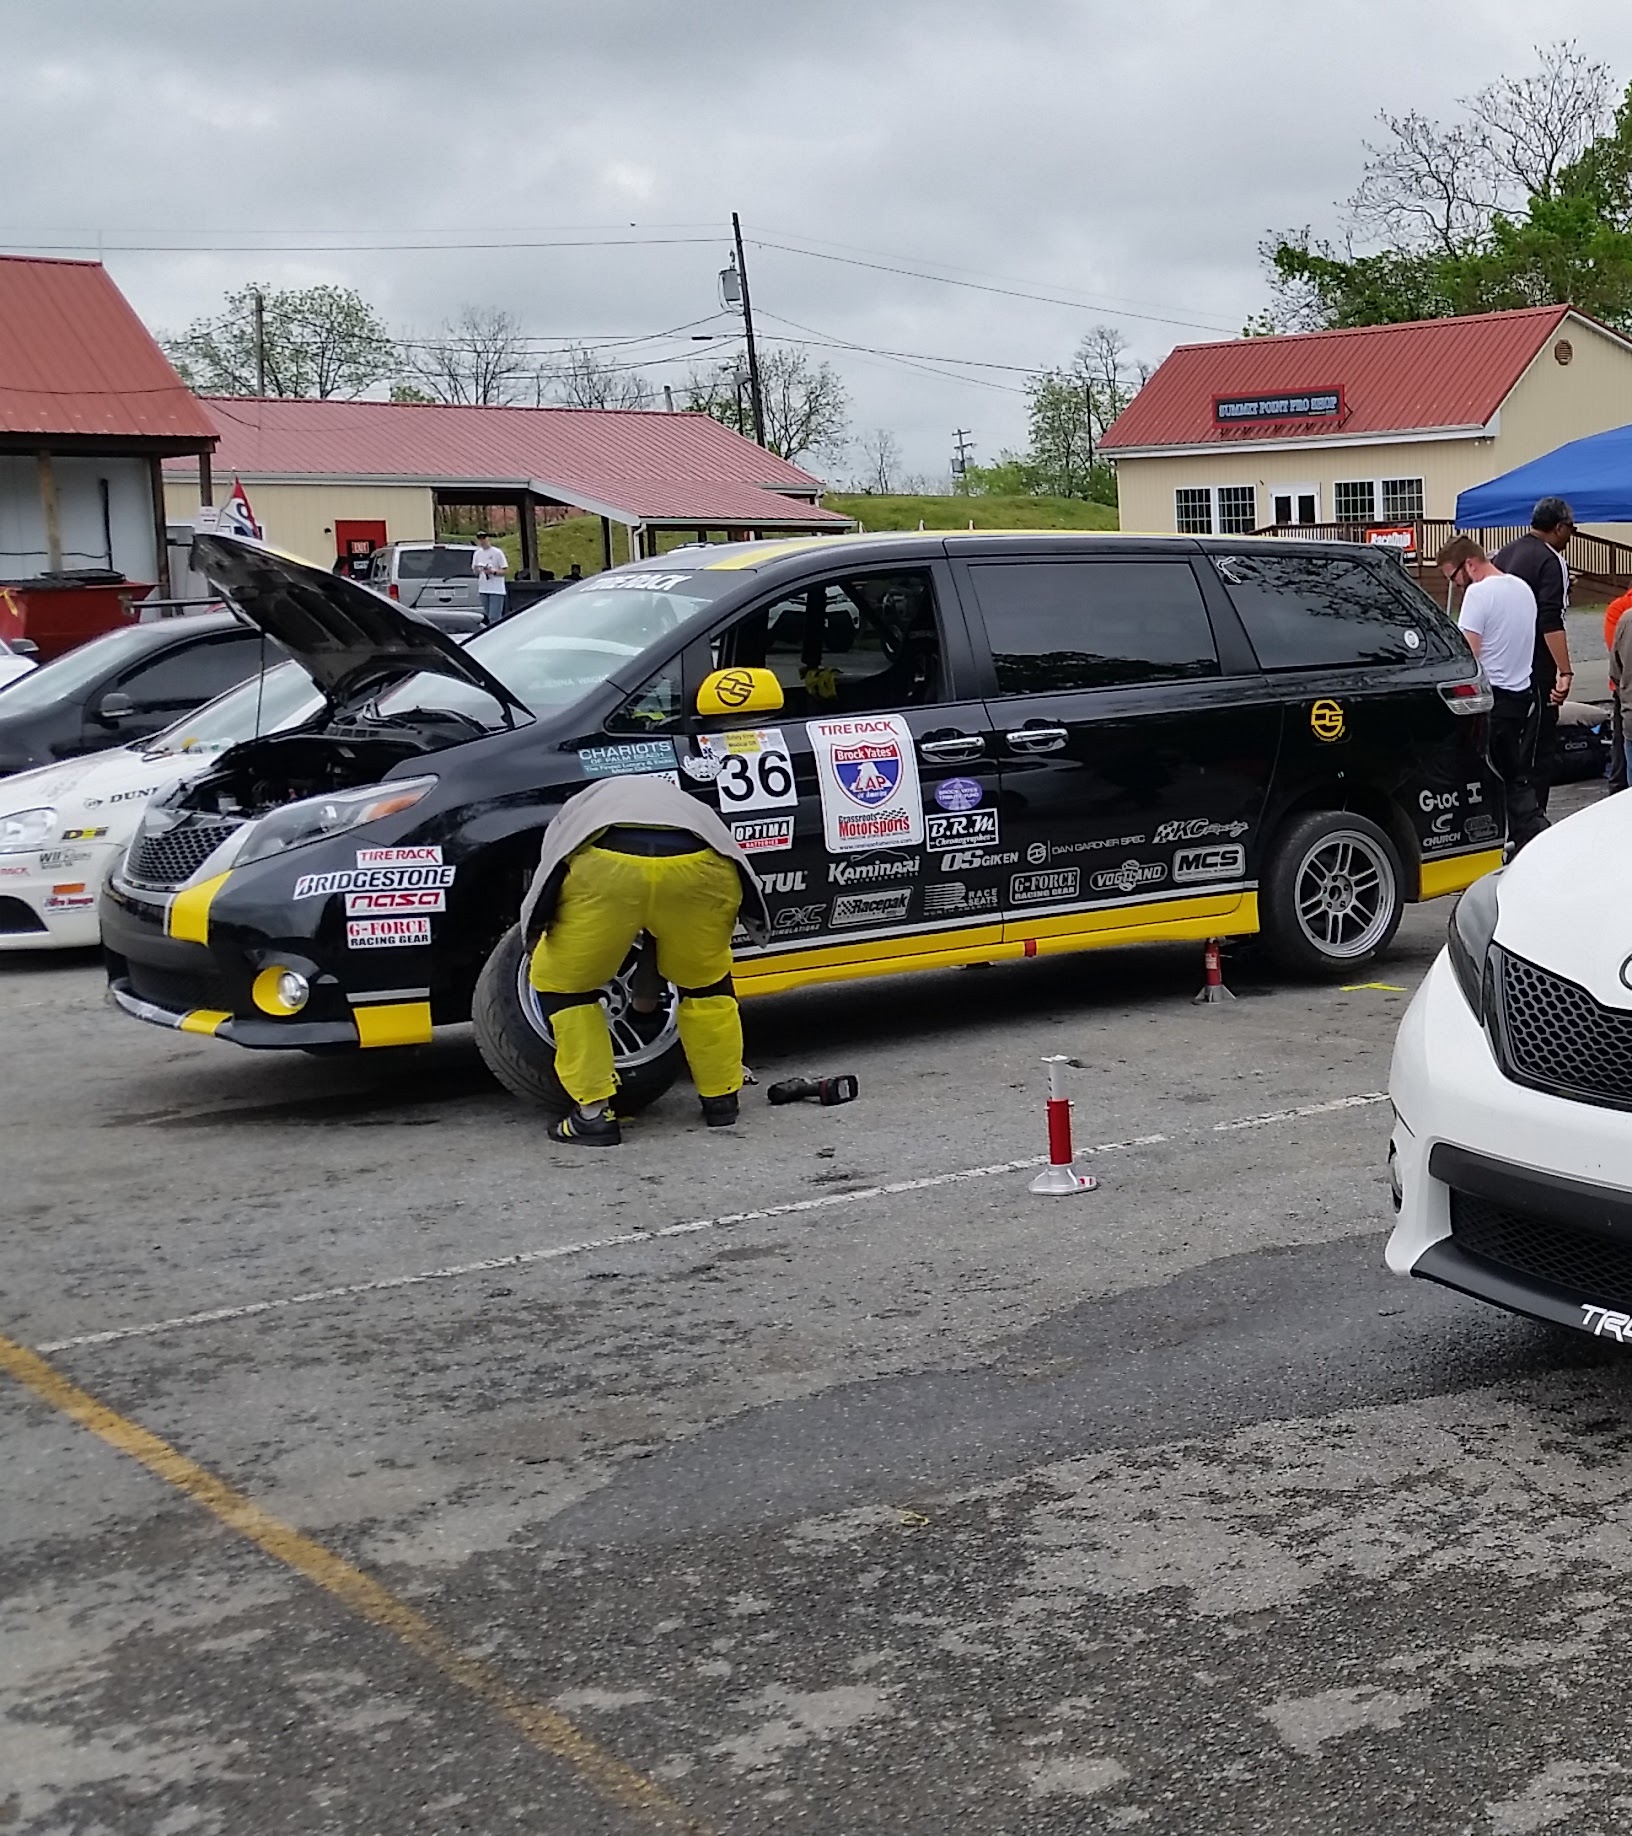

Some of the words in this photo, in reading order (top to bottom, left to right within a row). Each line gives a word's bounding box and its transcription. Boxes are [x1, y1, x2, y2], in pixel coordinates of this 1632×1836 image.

[1219, 403, 1258, 417] SUMMIT
[1259, 400, 1288, 414] POINT
[1290, 398, 1310, 412] PRO
[1311, 396, 1337, 410] SHOP
[352, 542, 369, 553] EXIT
[818, 724, 852, 735] TIRE
[854, 721, 898, 735] RACK
[579, 741, 671, 759] CHARIOTS
[836, 749, 864, 760] Brock
[720, 751, 792, 801] 36
[855, 775, 886, 791] LAP
[838, 813, 877, 823] Grassroots
[735, 822, 788, 841] OPTIMA
[839, 816, 910, 837] Motorsports
[746, 840, 778, 848] BATTERIES
[1052, 845, 1073, 854] DAN
[1075, 839, 1119, 850] GARDNER
[1121, 835, 1145, 845] SPEC
[361, 851, 393, 861] TIRE
[396, 849, 439, 863] RACK
[981, 852, 1019, 867] GIKEN
[1178, 850, 1239, 871] MCS
[297, 867, 453, 896] BRIDGESTONE
[757, 871, 804, 894] TUL
[1015, 872, 1076, 892] G-FORCE
[351, 892, 441, 908] nasa
[969, 888, 998, 897] RACE
[1015, 889, 1050, 900] RACING
[1052, 886, 1075, 896] GEAR
[851, 893, 909, 912] Racepak
[968, 896, 998, 906] SEATS
[349, 920, 427, 936] G-FORCE
[351, 936, 396, 946] RACING
[399, 934, 429, 944] GEAR
